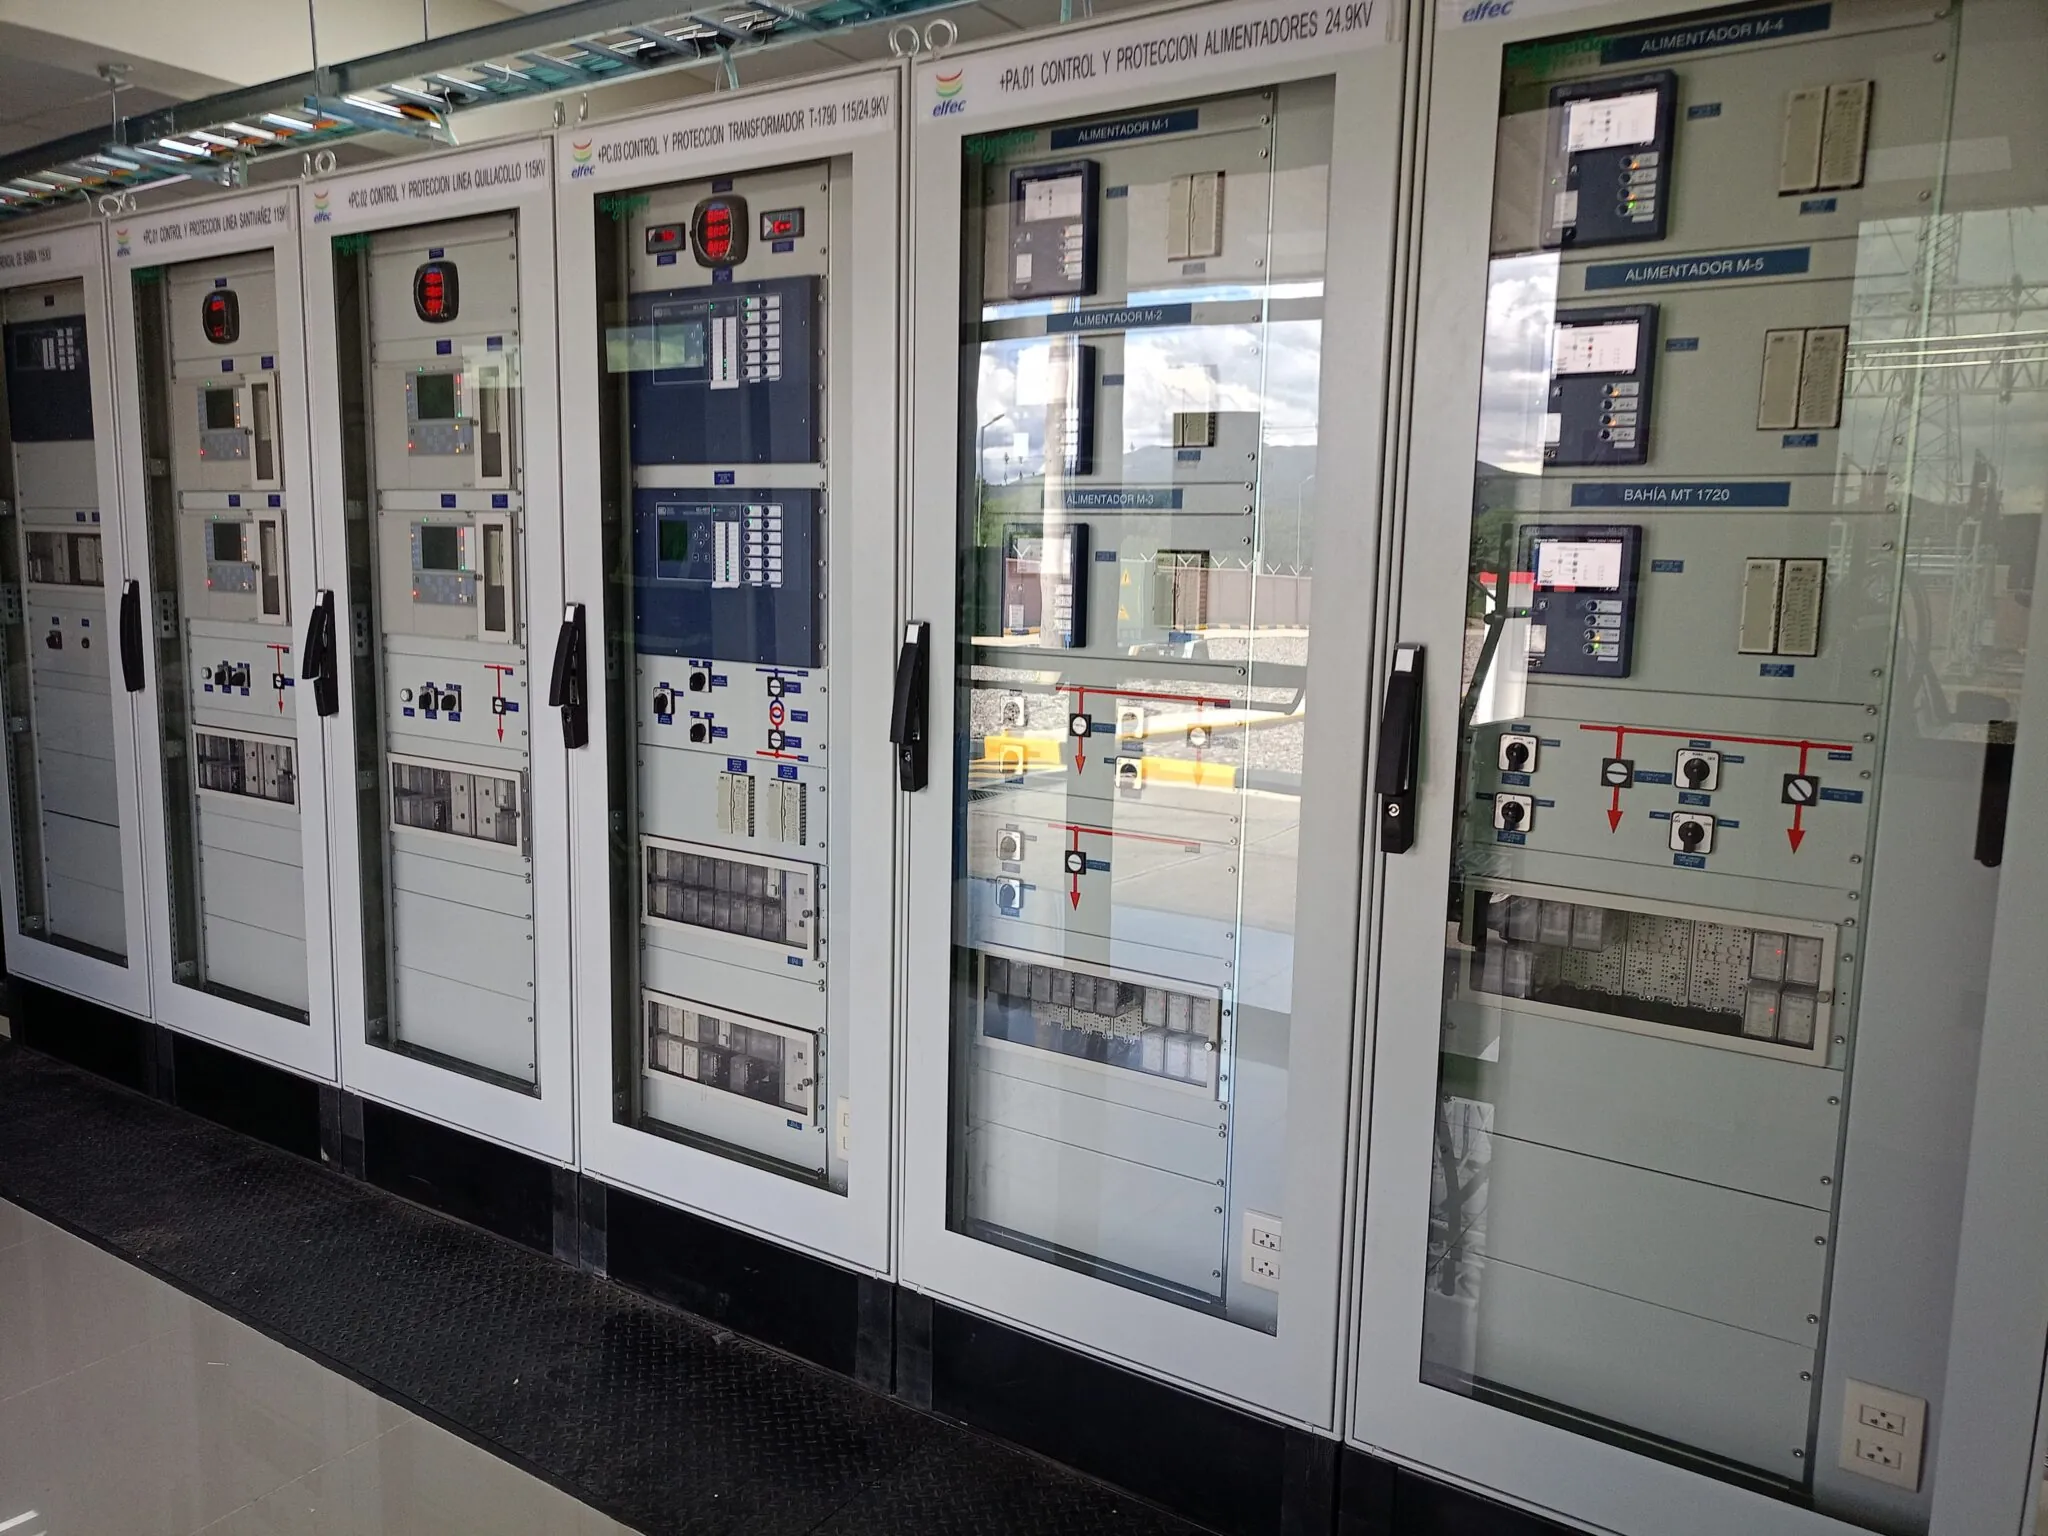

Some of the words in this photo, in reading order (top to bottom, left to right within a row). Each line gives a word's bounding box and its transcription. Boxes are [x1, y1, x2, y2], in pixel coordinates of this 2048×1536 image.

[1462, 0, 1514, 23] elfec
[999, 62, 1036, 93] +PA.01
[1040, 53, 1097, 87] CONTROL
[1102, 50, 1112, 75] Y
[1116, 35, 1199, 73] PROTECCION
[1203, 12, 1319, 55] ALIMENTADORES
[1324, 0, 1375, 34] 24.9KV
[1640, 23, 1752, 54] ALIMENTADOR
[1756, 18, 1785, 37] M-4
[932, 99, 967, 117] elfec
[623, 136, 660, 161] CONTROL
[663, 133, 670, 153] Y
[672, 124, 725, 151] PROTECCION
[728, 108, 805, 142] TRANSFORMADOR
[809, 103, 837, 128] T-1790
[842, 95, 890, 123] 115/24.9KV
[1077, 121, 1150, 142] ALIMENTADOR
[1150, 118, 1170, 133] M-1
[369, 184, 400, 206] CONTROL
[401, 182, 407, 200] Y
[408, 176, 450, 198] PROTECCION
[453, 172, 472, 192] LINEA
[474, 165, 522, 188] QUILLACOLLO
[525, 159, 547, 178] 115KV
[571, 163, 596, 179] elfec
[159, 224, 183, 243] CONTROL
[189, 218, 221, 237] PROTECCION
[1624, 260, 1734, 283] ALIMENTADOR
[1737, 257, 1765, 272] M-5
[1073, 311, 1143, 326] ALIMENTADOR
[1144, 309, 1163, 322] M-2
[1066, 494, 1134, 505] ALIMENTADOR
[1135, 493, 1154, 505] M-3
[1624, 484, 1667, 502] BAHÍA
[1671, 488, 1694, 502] MT
[1696, 488, 1731, 502] 1720
